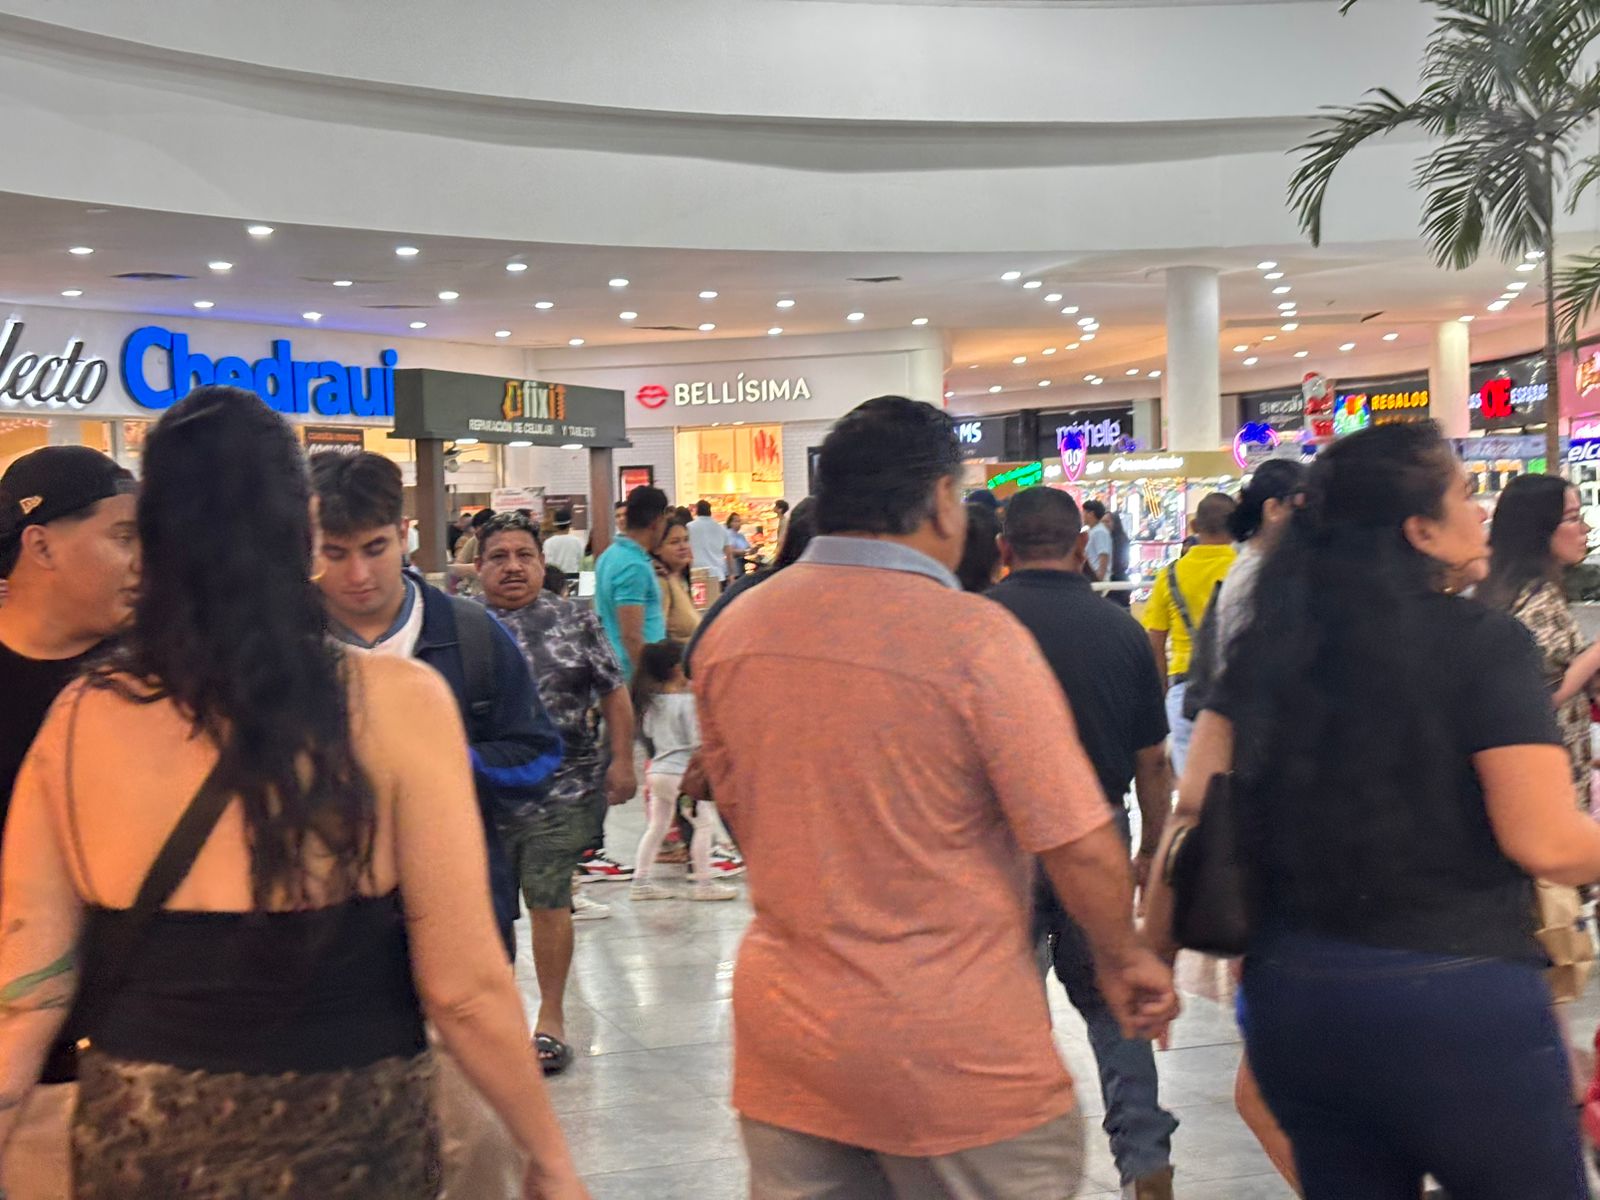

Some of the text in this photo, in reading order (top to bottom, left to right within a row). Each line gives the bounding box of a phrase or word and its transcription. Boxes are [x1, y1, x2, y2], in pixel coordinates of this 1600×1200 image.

[122, 326, 397, 416] Chedraui
[674, 372, 811, 406] BELLÍSIMA
[1371, 390, 1429, 410] REGALOS
[954, 422, 982, 443] MS
